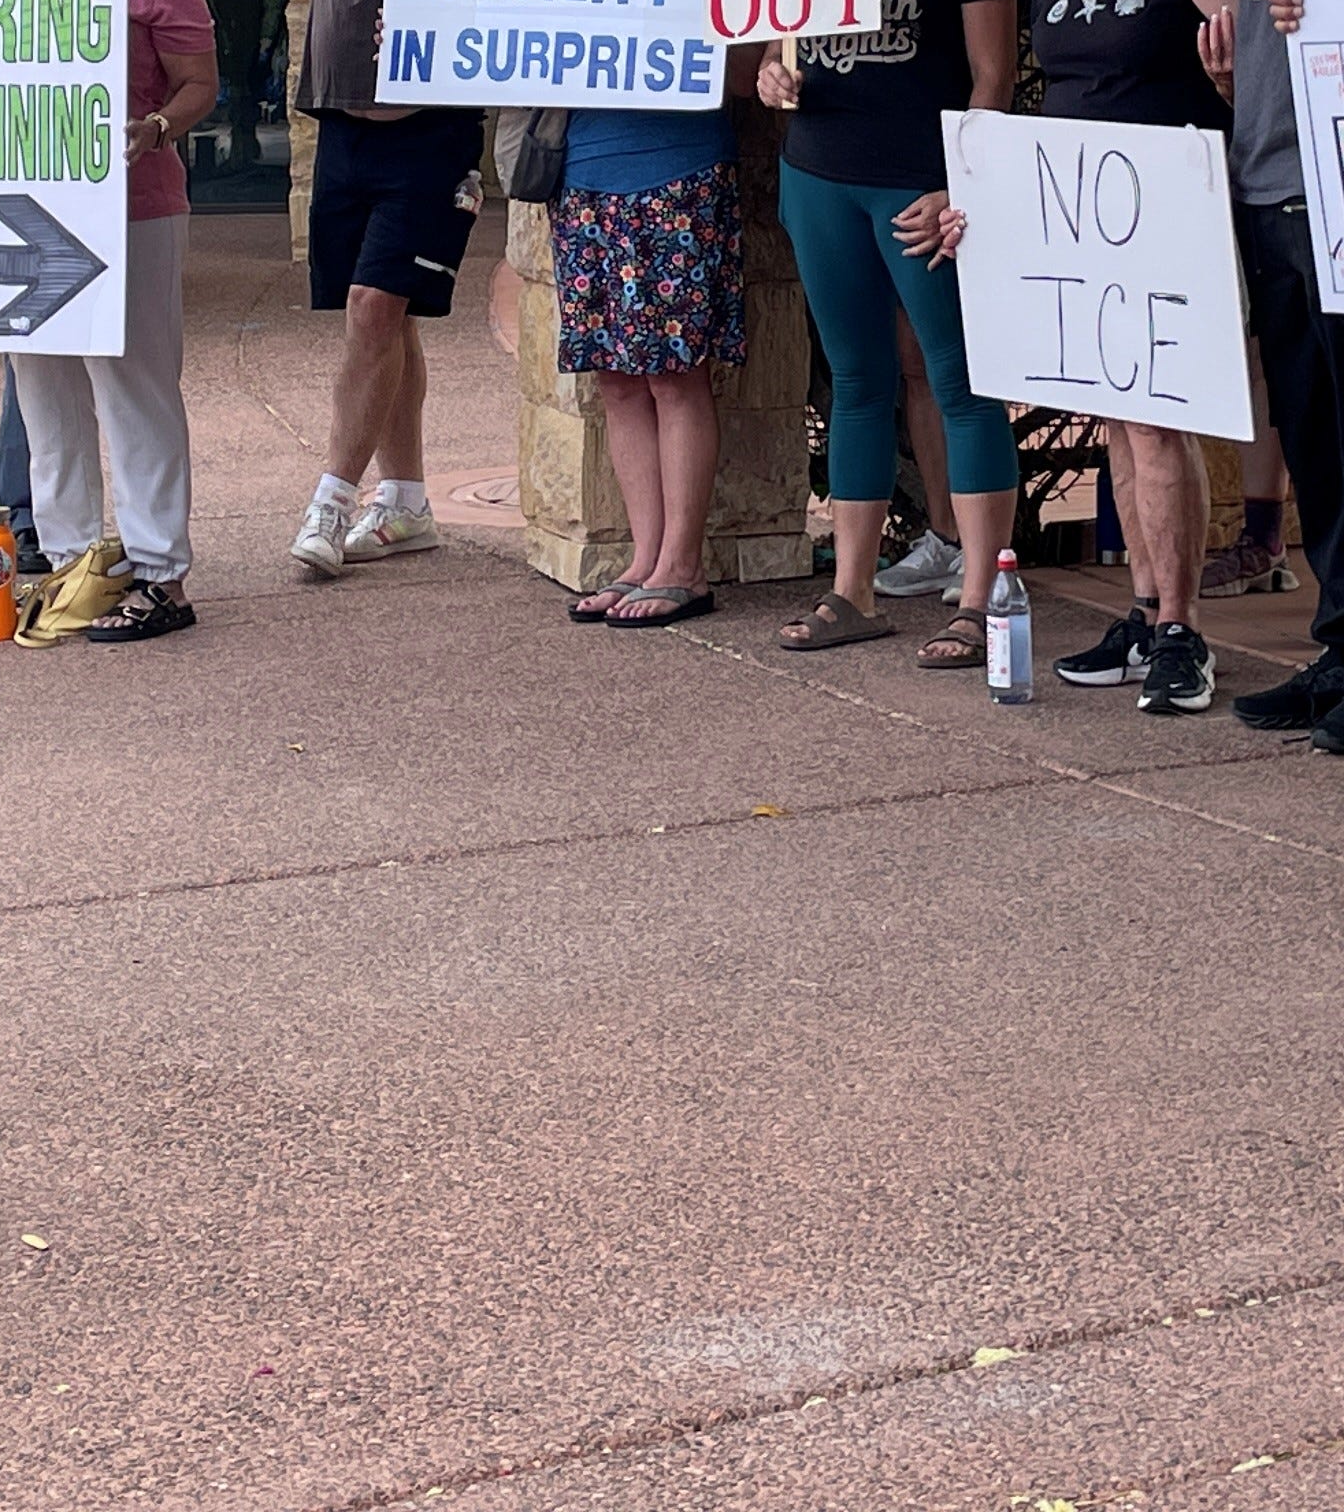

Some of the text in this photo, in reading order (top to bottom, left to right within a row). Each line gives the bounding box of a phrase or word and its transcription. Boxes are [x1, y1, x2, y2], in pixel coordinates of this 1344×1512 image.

[388, 28, 714, 94] IN SURPRISE
[1036, 140, 1141, 246] NO
[1020, 275, 1189, 404] ICE
